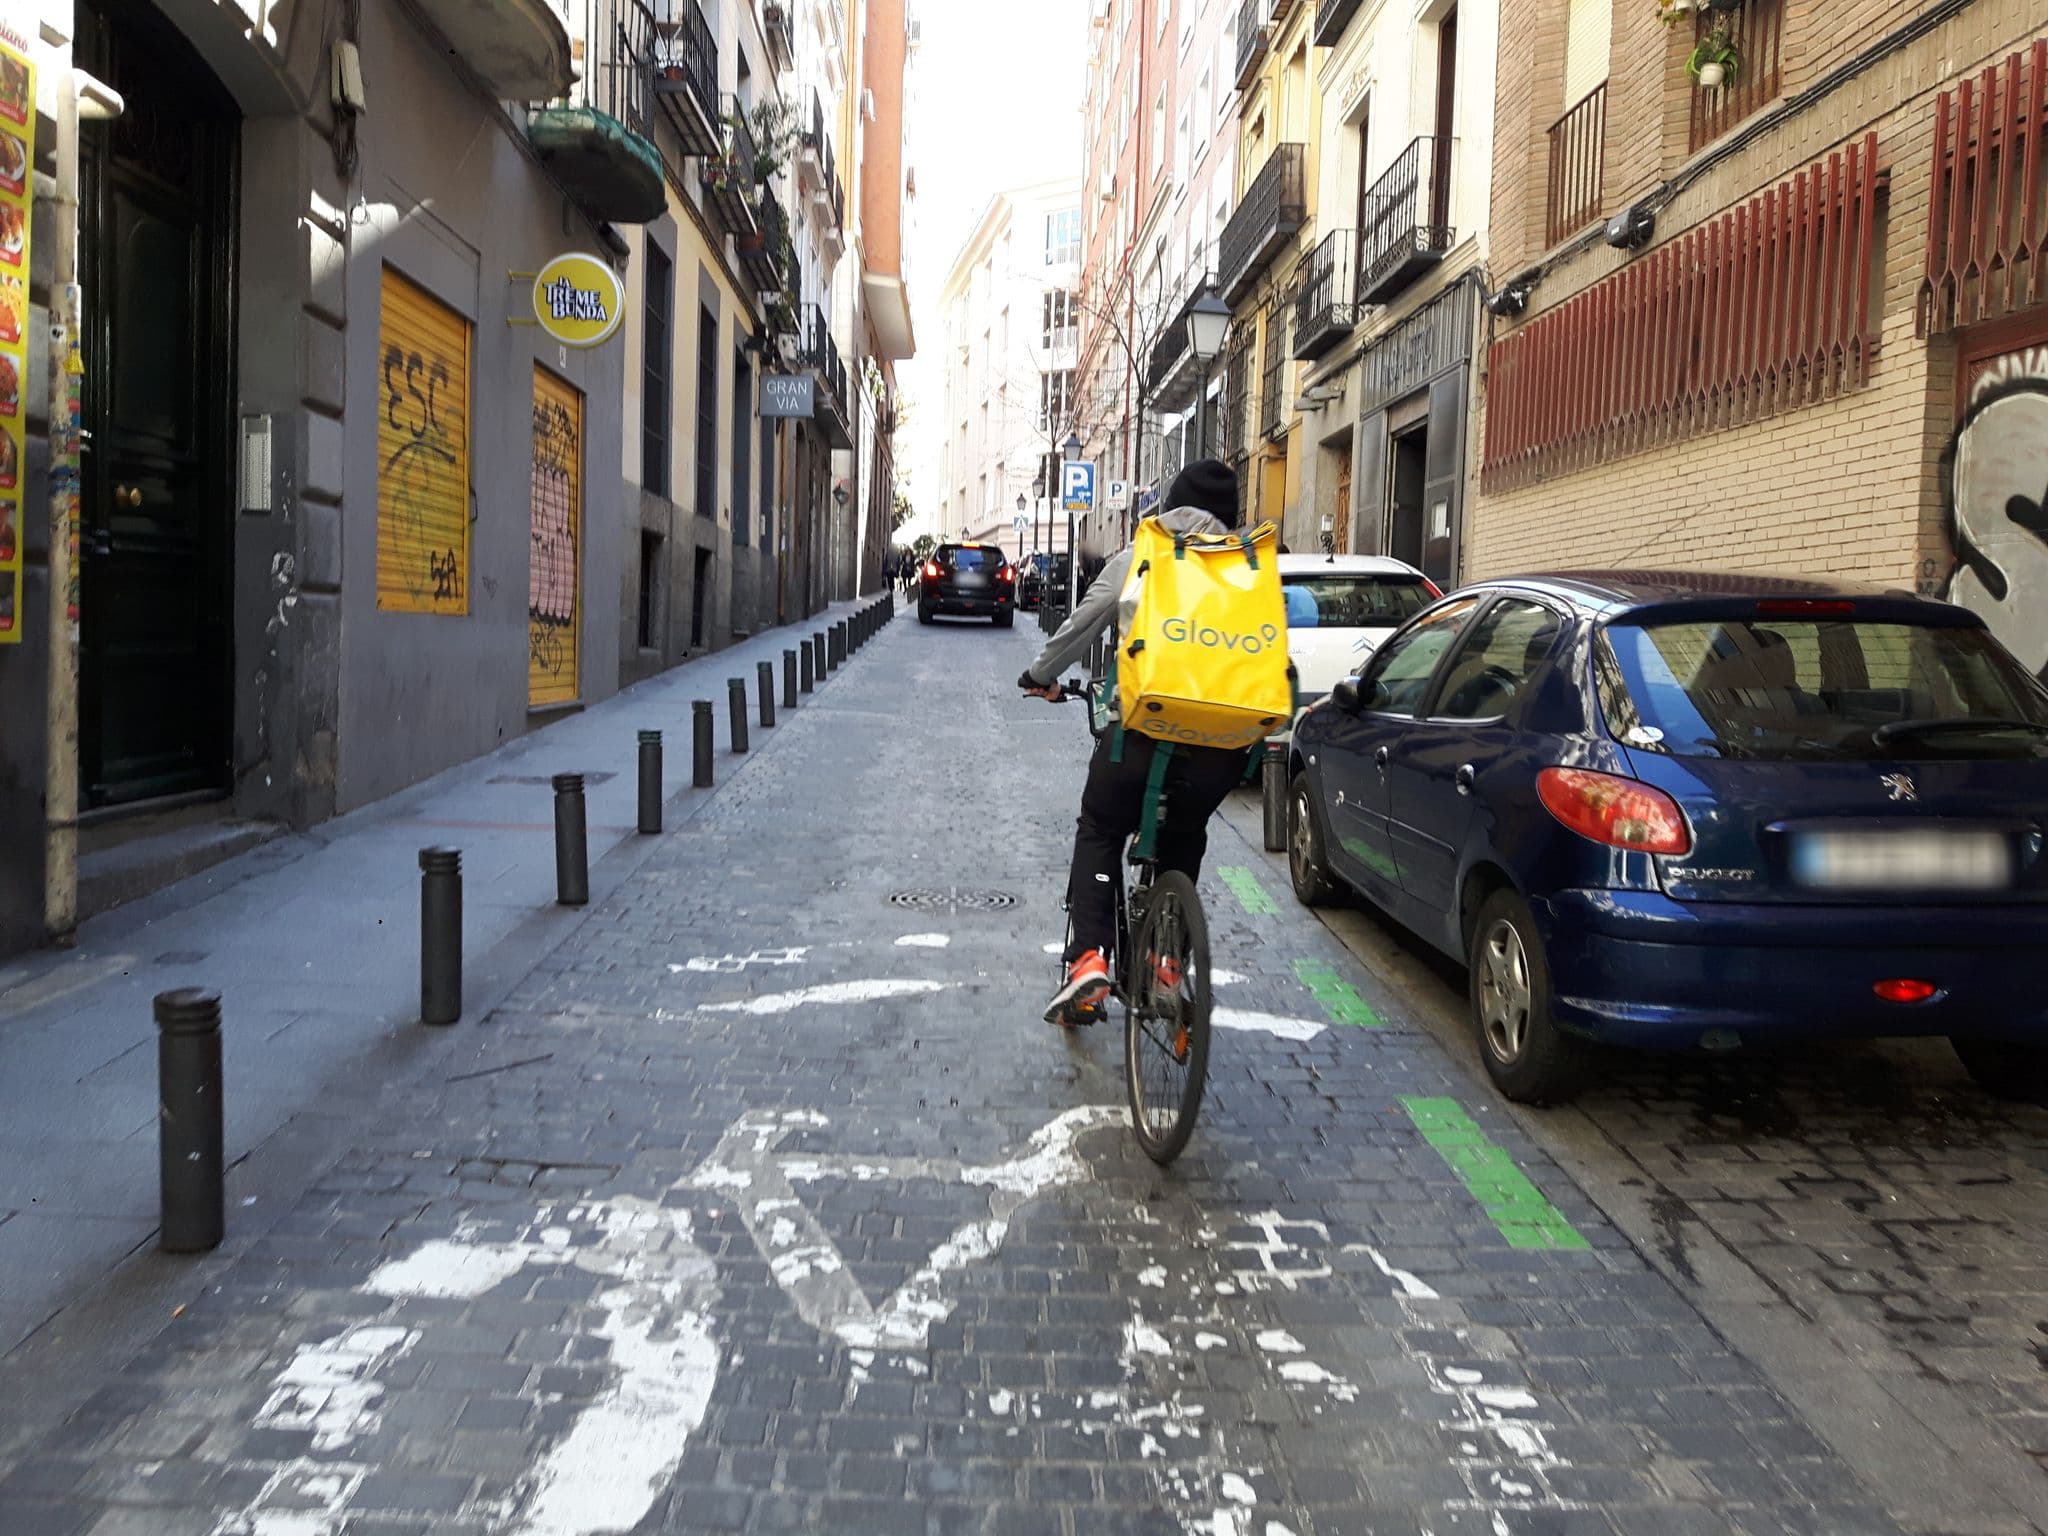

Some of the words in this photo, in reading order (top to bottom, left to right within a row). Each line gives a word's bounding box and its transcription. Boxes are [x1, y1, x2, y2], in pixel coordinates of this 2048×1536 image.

[543, 283, 601, 306] TREME
[552, 300, 607, 322] BUNDA
[766, 380, 807, 396] GRAN
[776, 396, 799, 411] VIA
[1065, 464, 1089, 497] P
[1111, 483, 1122, 497] P
[1163, 618, 1261, 654] Glovo
[1141, 718, 1240, 744] Glovo
